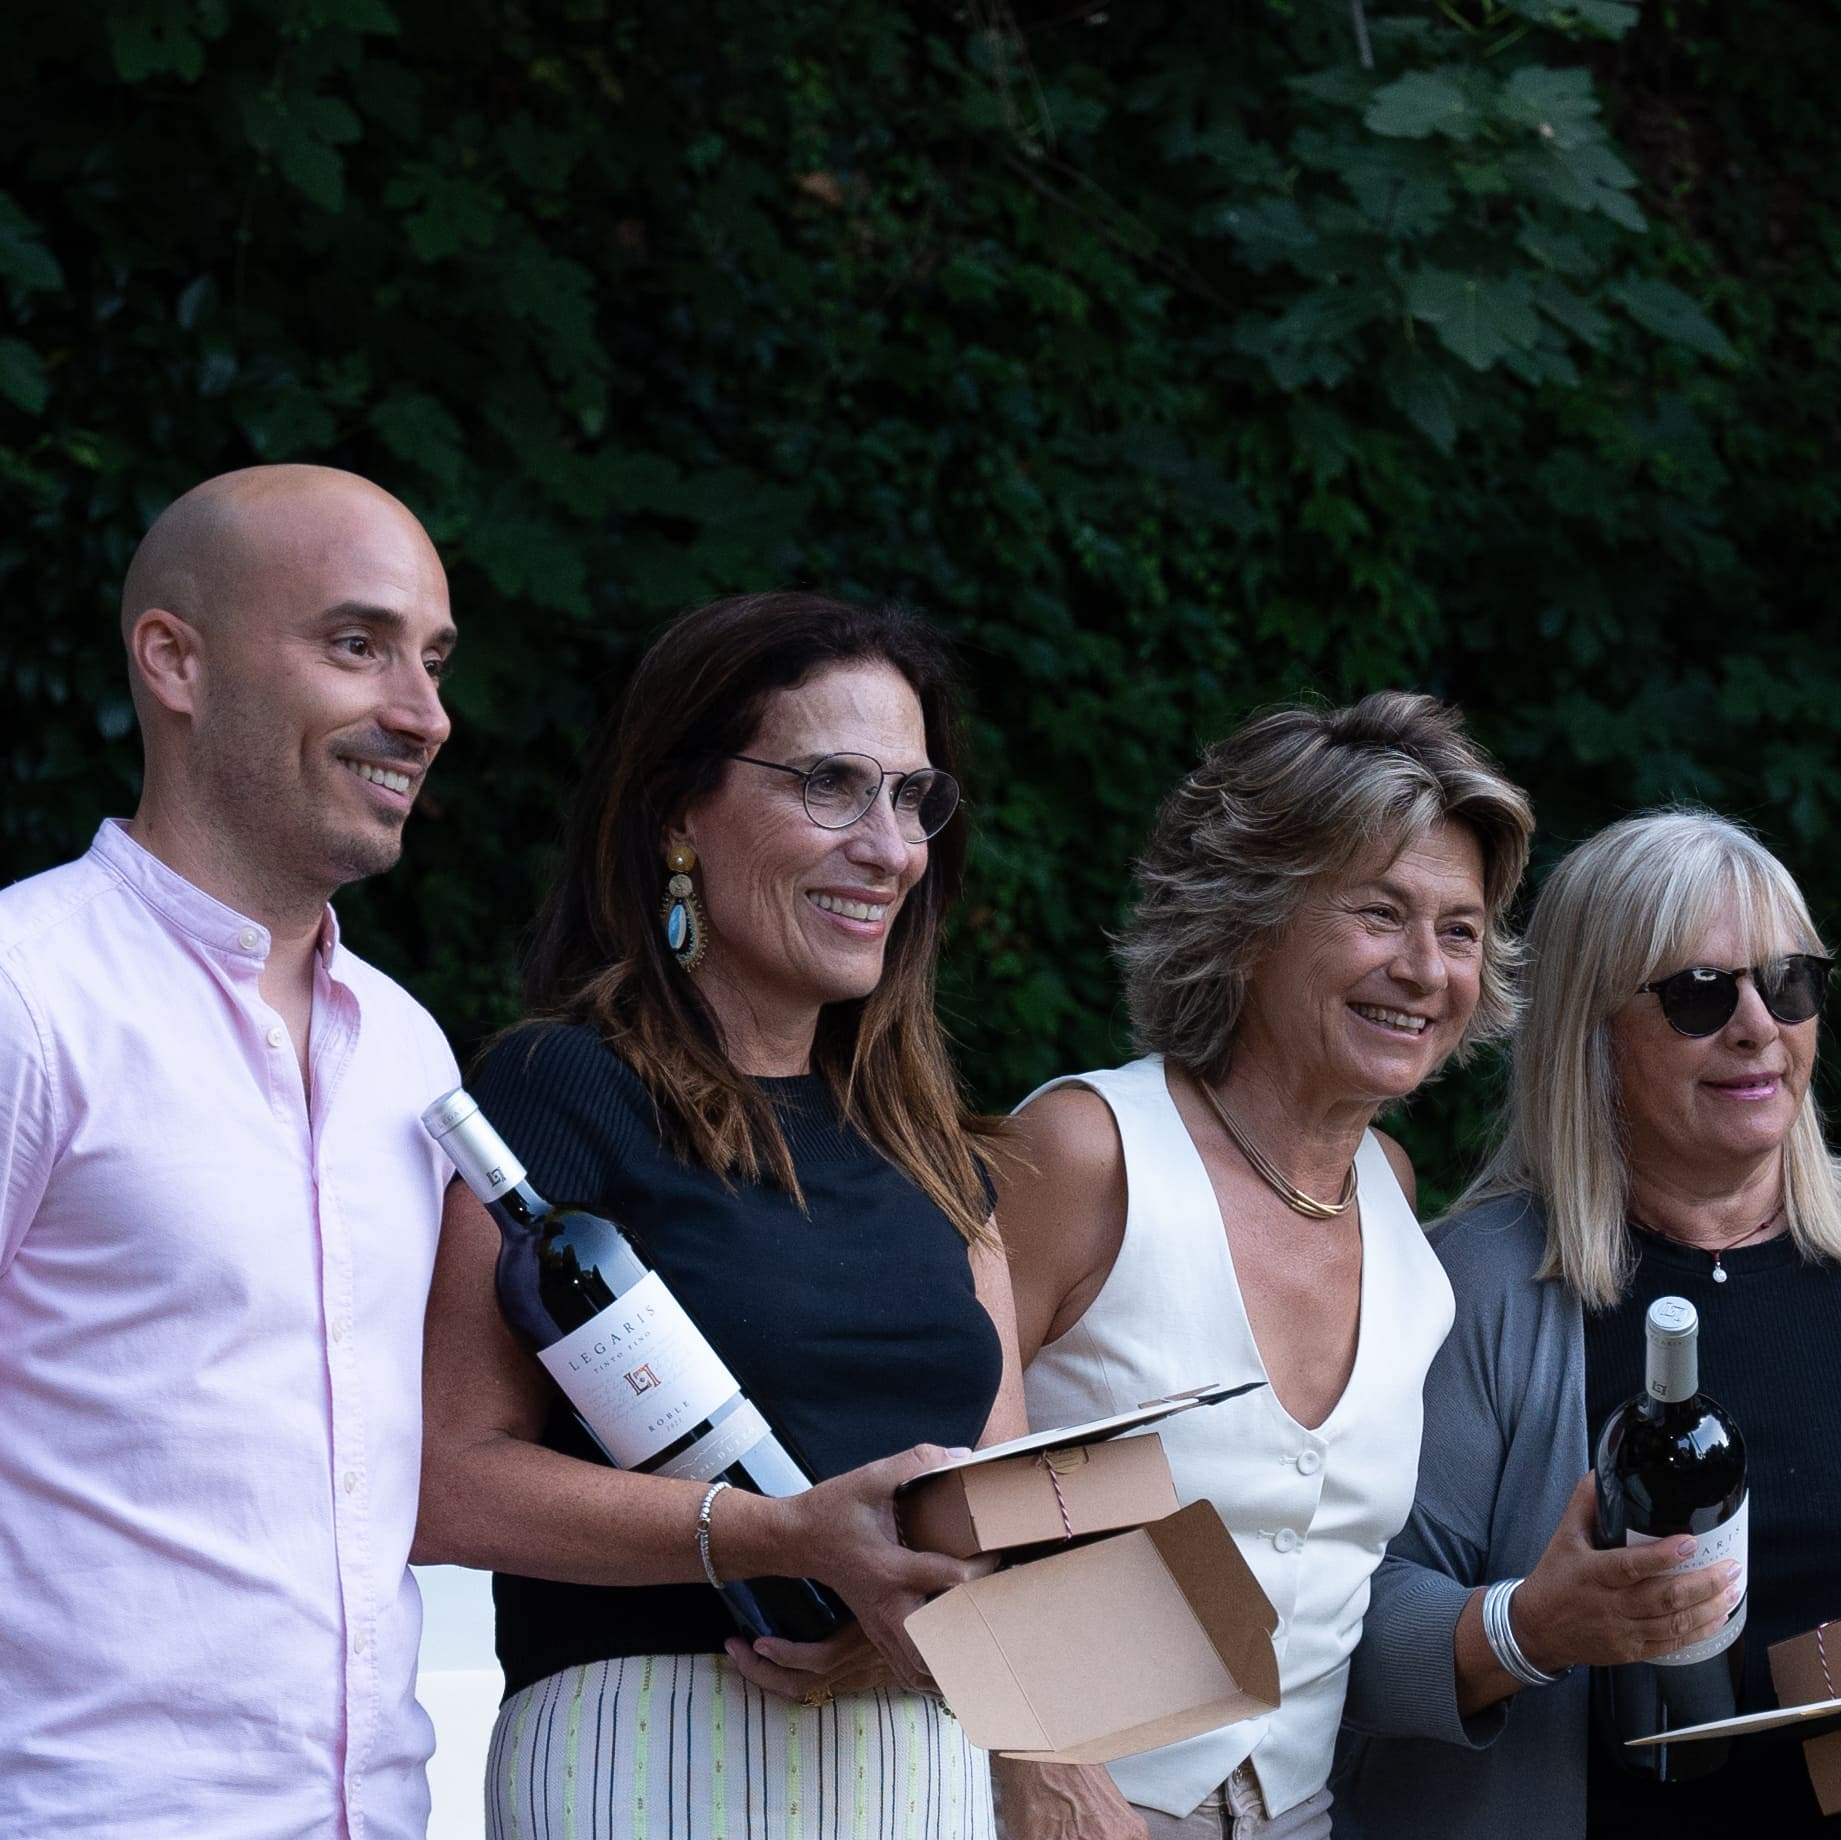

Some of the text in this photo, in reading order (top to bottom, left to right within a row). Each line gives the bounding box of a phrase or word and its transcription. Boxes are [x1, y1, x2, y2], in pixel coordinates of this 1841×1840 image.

[568, 1304, 656, 1372] LEGARIS
[594, 1352, 624, 1374] TINTO
[648, 1400, 688, 1432] ROBLE
[1696, 1523, 1740, 1556] ARIS
